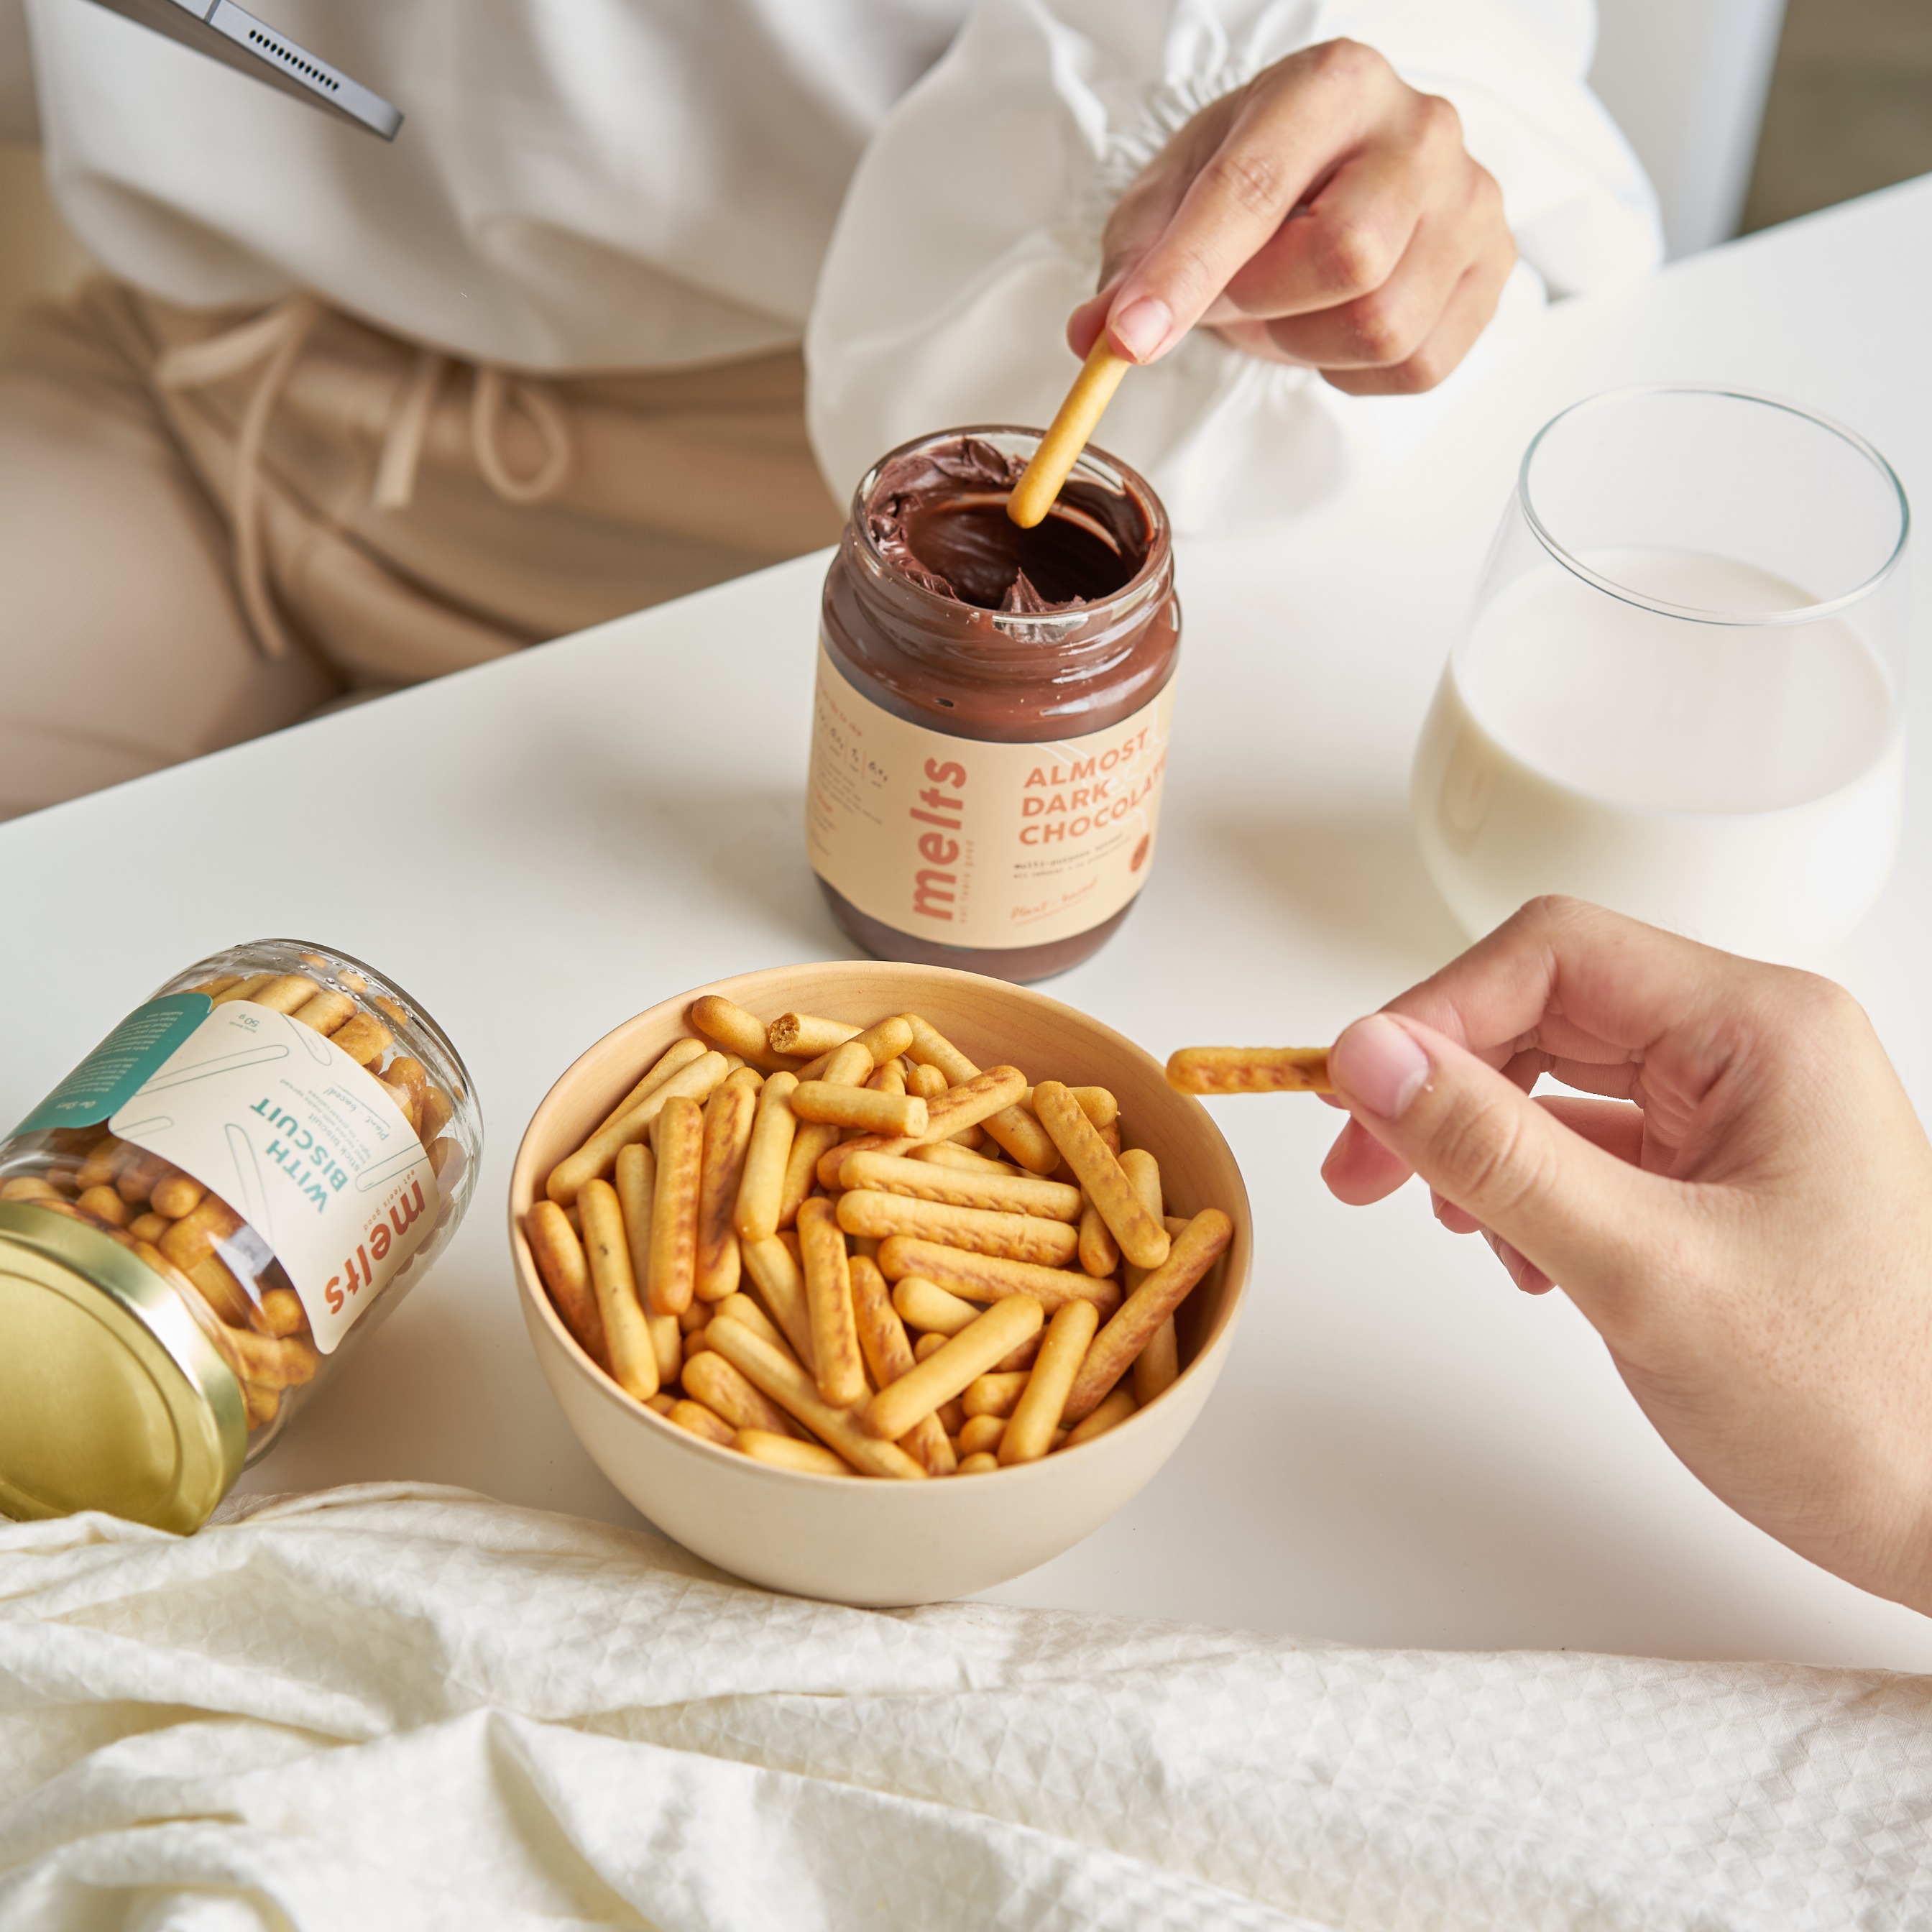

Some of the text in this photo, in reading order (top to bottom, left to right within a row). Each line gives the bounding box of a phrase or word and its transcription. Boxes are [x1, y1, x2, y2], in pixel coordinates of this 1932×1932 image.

[1024, 726, 1148, 788] ALMOST
[1022, 780, 1110, 816] DARK
[910, 758, 967, 921] melts
[244, 1018, 259, 1027] 50
[323, 1086, 357, 1112] based!
[364, 1116, 390, 1140] Plant
[249, 1097, 349, 1192] BISCUIT
[308, 1112, 359, 1171] stick biscuit
[264, 1138, 327, 1213] WITH
[362, 1169, 415, 1231] eat feels good
[322, 1179, 425, 1315] melts
